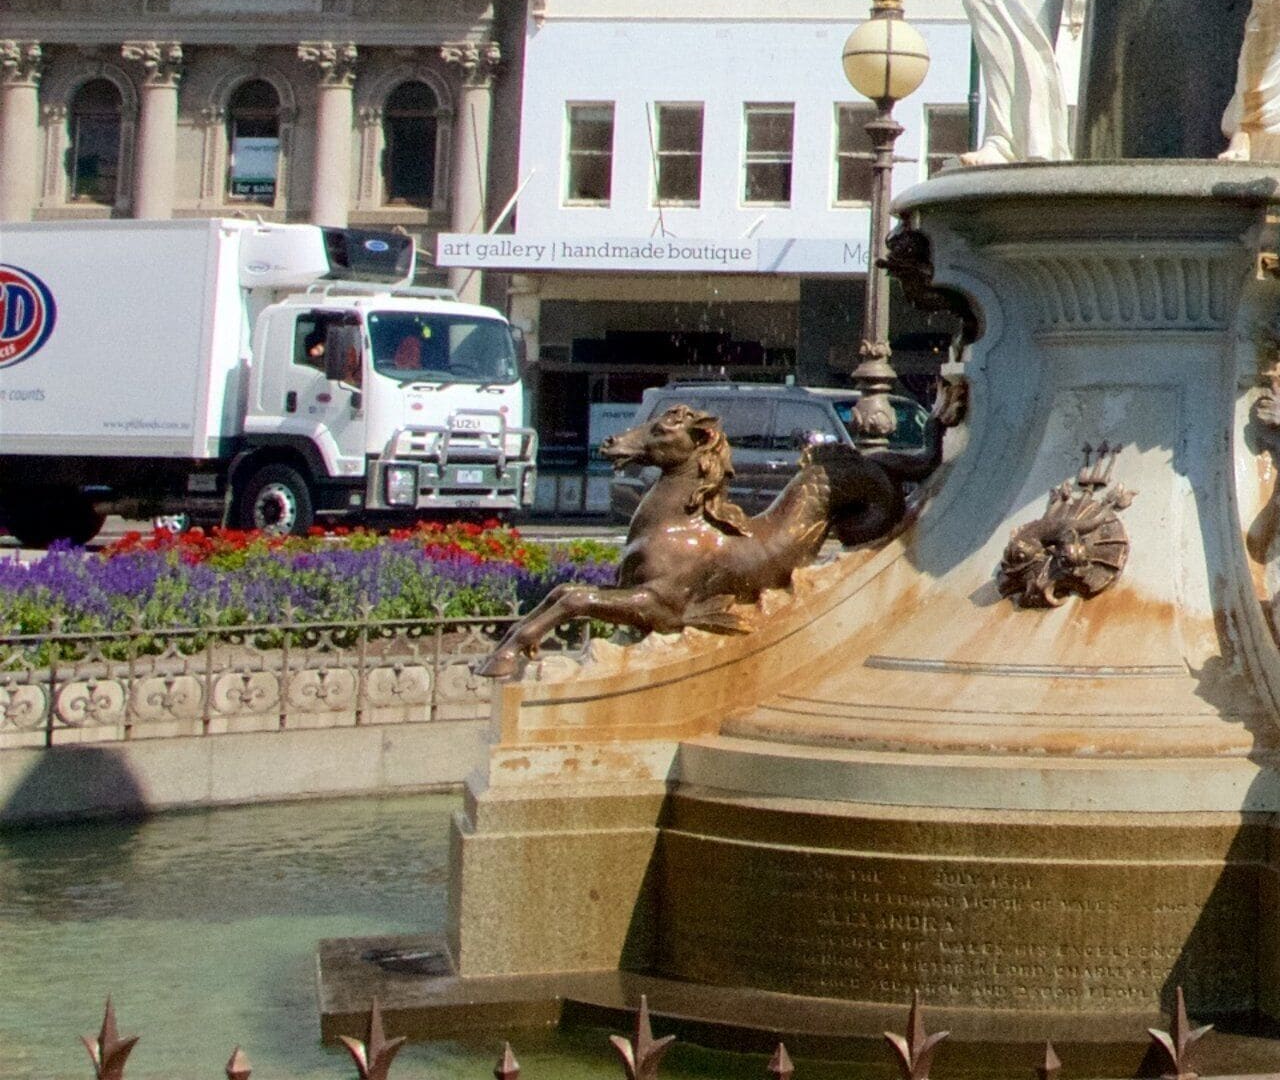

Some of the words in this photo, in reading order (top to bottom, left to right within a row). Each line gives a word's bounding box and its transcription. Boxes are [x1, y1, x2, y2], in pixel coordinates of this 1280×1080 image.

[444, 241, 470, 256] art
[476, 241, 546, 262] gallery
[561, 241, 665, 260] handmade
[668, 243, 753, 264] boutique
[9, 388, 45, 401] counts
[1056, 944, 1182, 959] EXCELLENC
